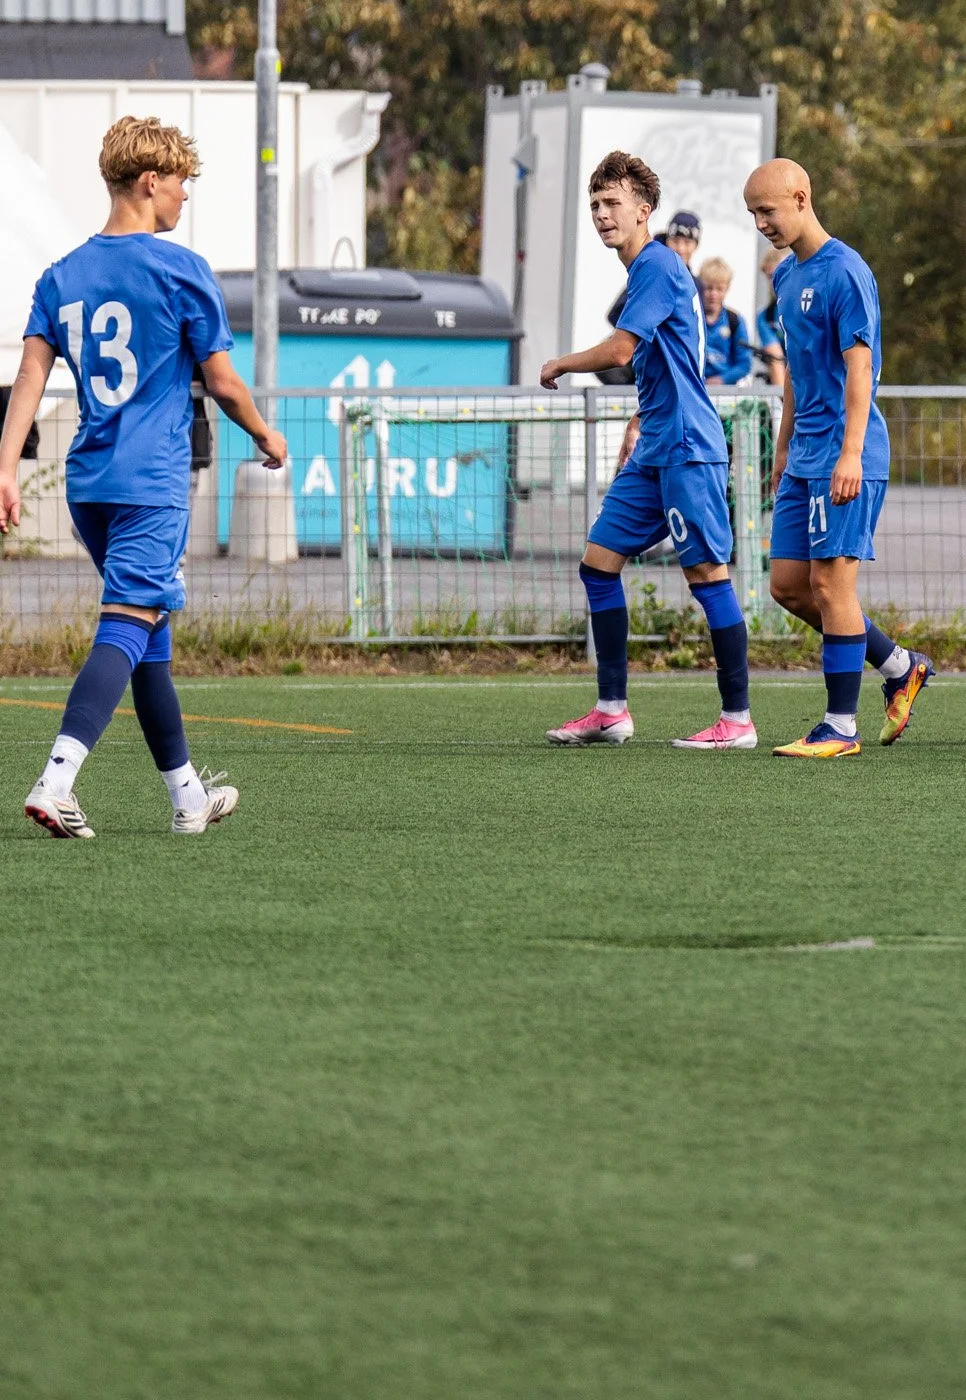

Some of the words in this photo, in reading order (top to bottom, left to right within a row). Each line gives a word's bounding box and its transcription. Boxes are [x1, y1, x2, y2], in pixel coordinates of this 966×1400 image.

[58, 300, 138, 407] 13
[664, 507, 688, 543] 0
[808, 496, 827, 533] 21
